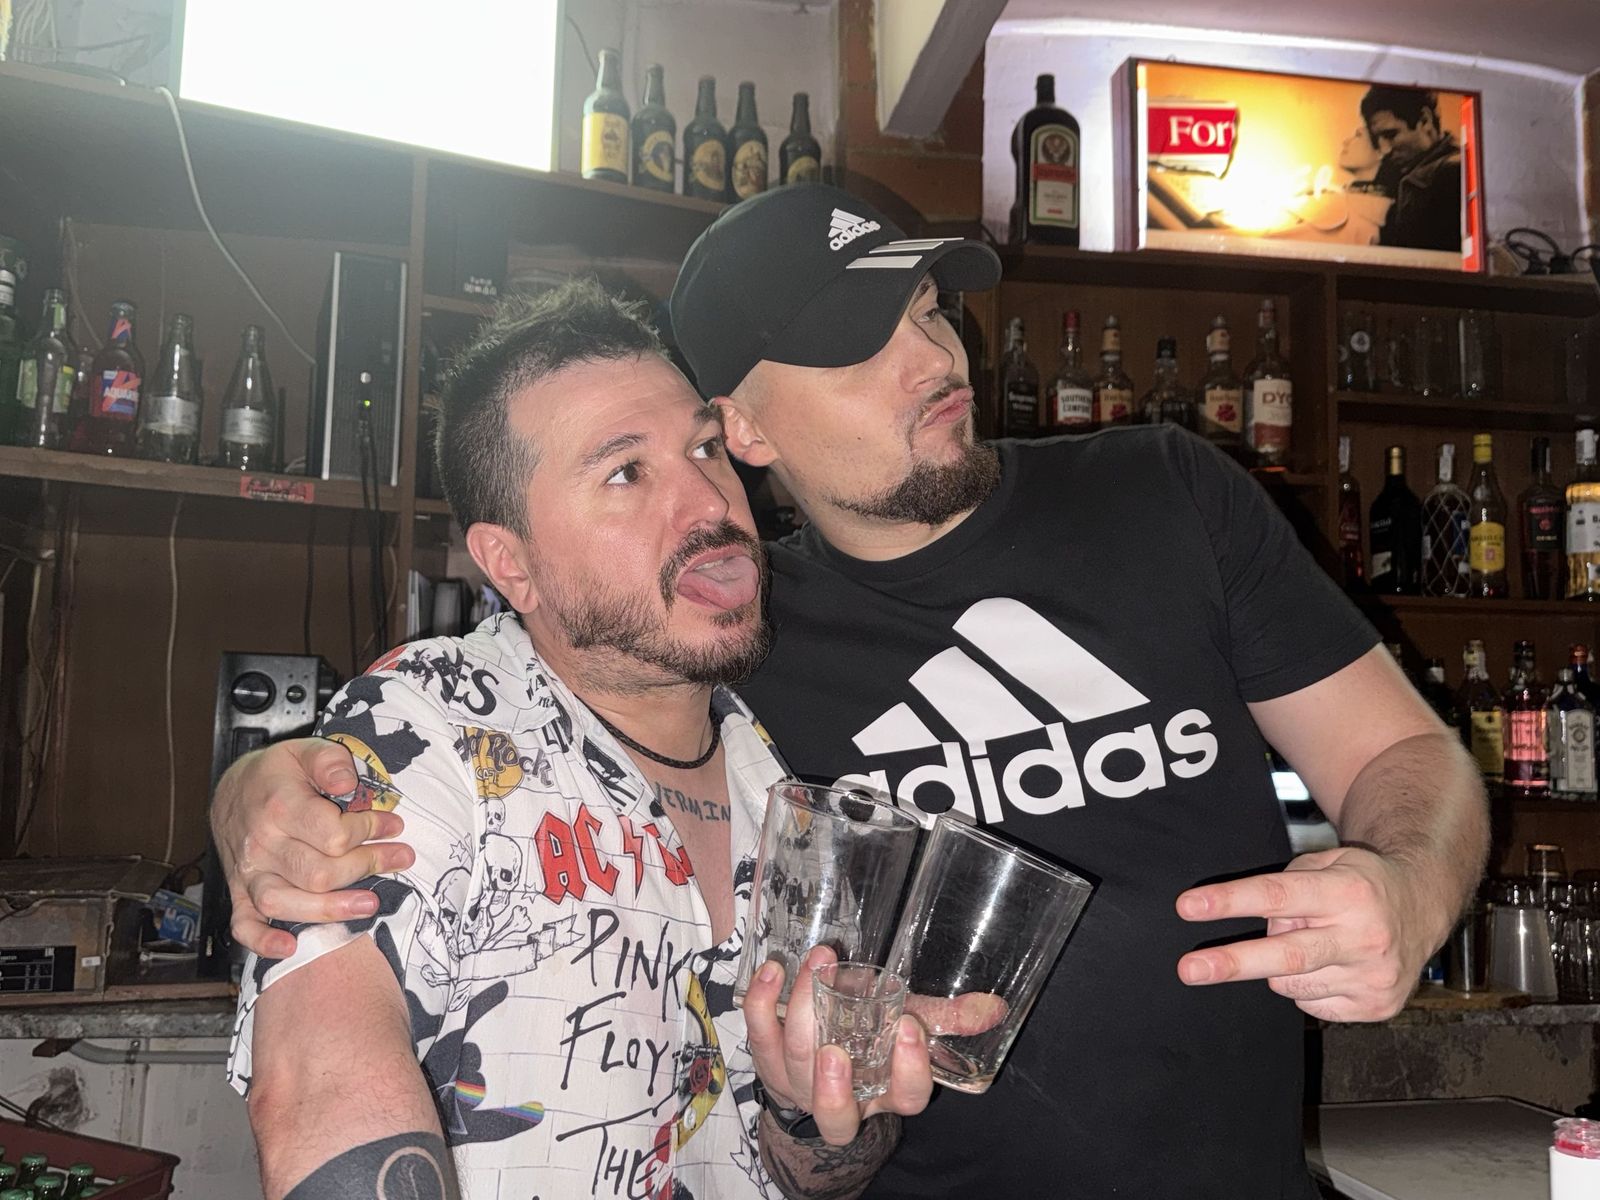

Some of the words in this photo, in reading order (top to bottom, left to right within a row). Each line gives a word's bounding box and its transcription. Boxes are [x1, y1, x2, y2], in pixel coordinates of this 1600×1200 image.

[1169, 116, 1236, 147] For
[829, 220, 881, 251] adidas
[1061, 394, 1093, 404] SOUTHE
[1062, 404, 1091, 415] COMFOR
[830, 709, 1219, 831] adidas
[571, 908, 693, 1023] PINK
[557, 1088, 678, 1200] THE
